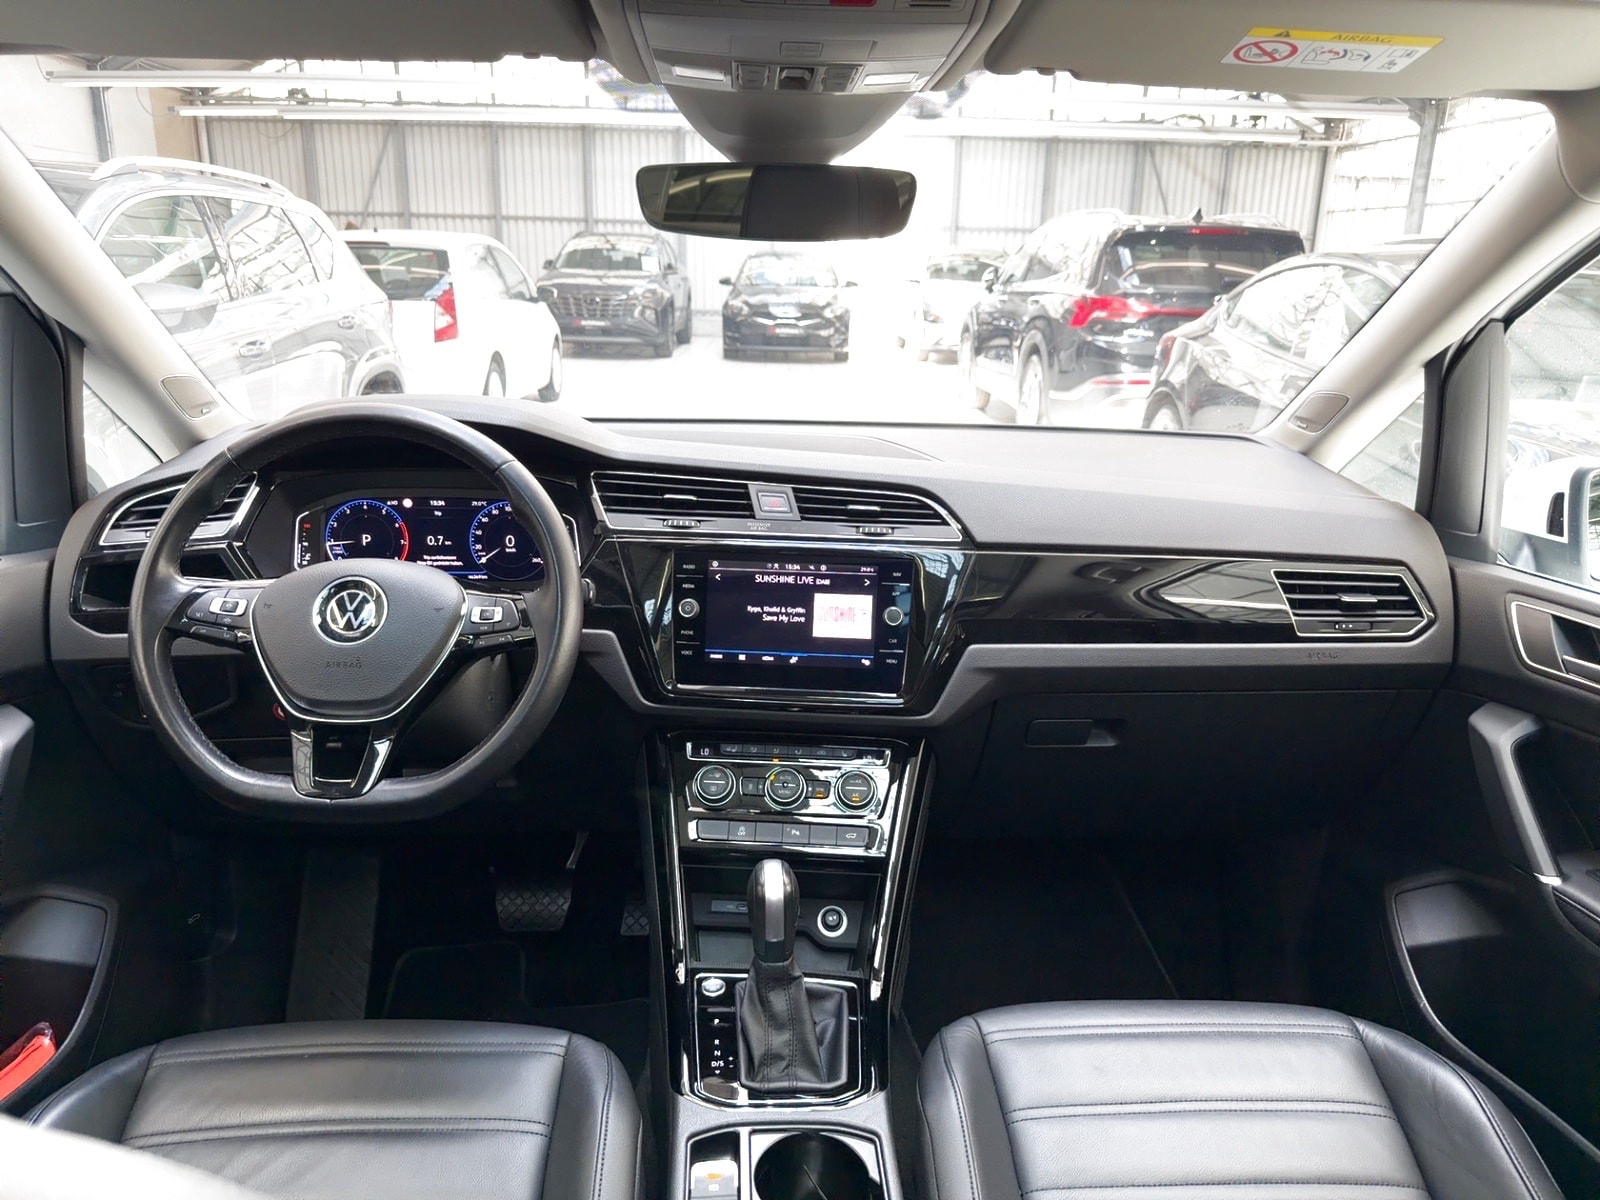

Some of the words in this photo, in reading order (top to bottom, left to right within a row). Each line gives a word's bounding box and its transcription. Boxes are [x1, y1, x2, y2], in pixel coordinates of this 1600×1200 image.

[1330, 34, 1395, 44] AIRBAG
[362, 534, 372, 546] P
[426, 535, 444, 546] 0.7
[505, 535, 515, 547] 0
[754, 574, 796, 584] SUNSHINE
[797, 576, 815, 585] LIVE
[762, 613, 778, 622] Save
[778, 614, 789, 623] My
[789, 615, 806, 623] Love
[325, 661, 362, 670] AIRBAG
